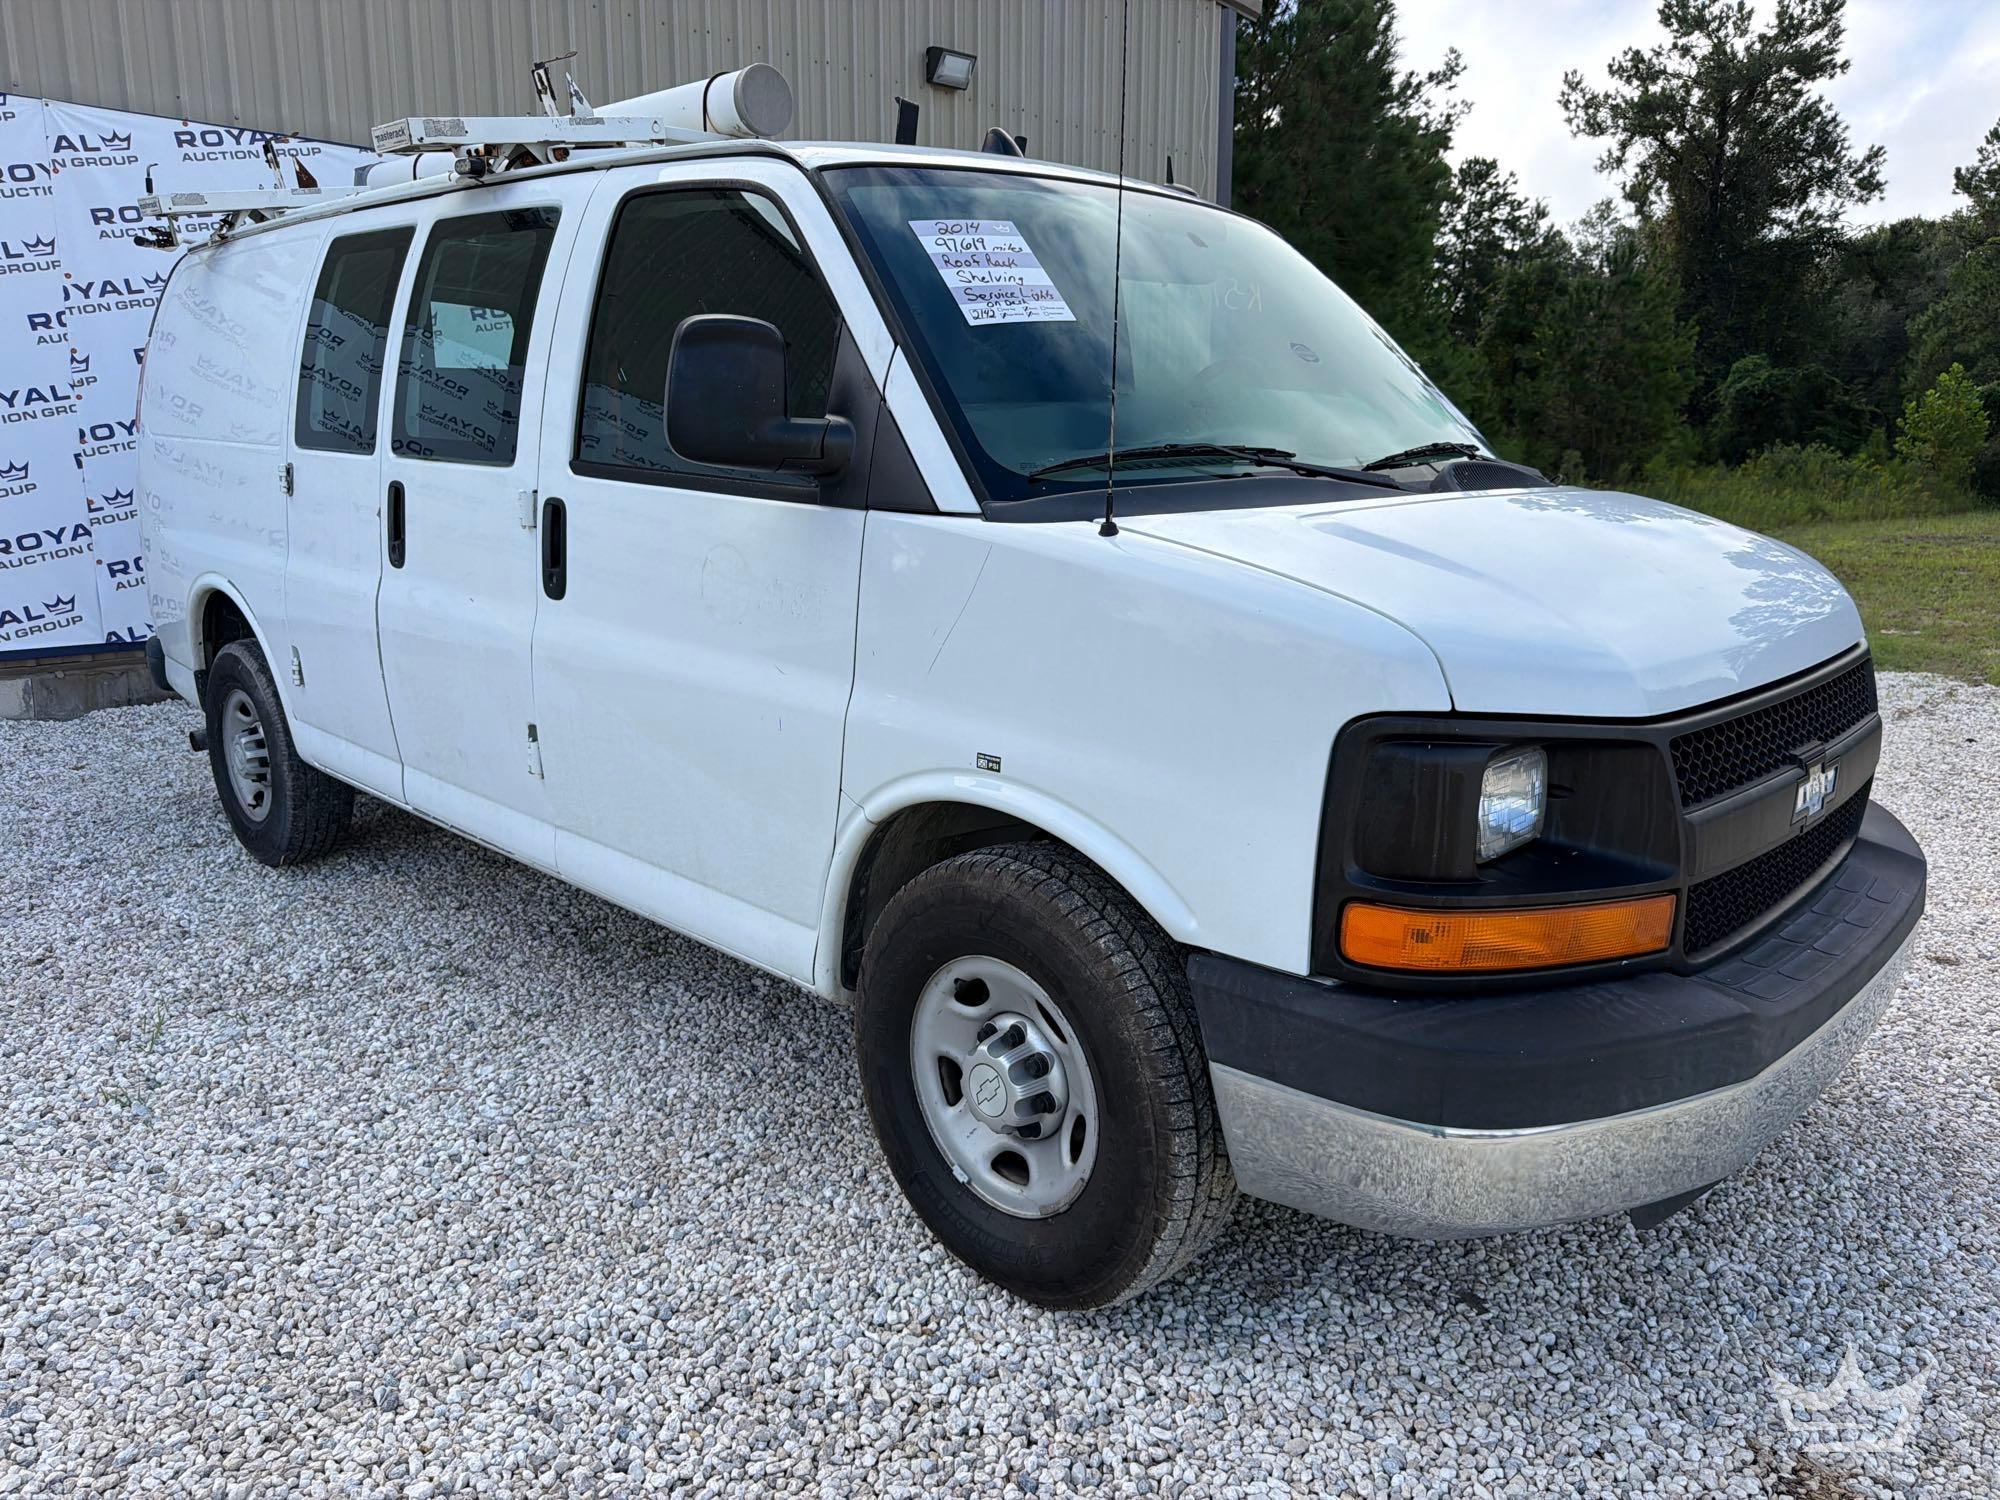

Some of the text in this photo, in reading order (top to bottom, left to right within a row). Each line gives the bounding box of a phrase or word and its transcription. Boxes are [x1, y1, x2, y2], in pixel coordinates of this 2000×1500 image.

[71, 155, 139, 168] GROUP
[182, 147, 322, 162] AUCTION ROUP
[0, 163, 51, 183] OY
[0, 185, 53, 199] UCTI
[934, 221, 981, 236] 2014
[934, 236, 987, 254] 97,619
[956, 270, 1024, 286] Shelving
[963, 287, 1019, 302] Service
[14, 614, 84, 639] GROUP
